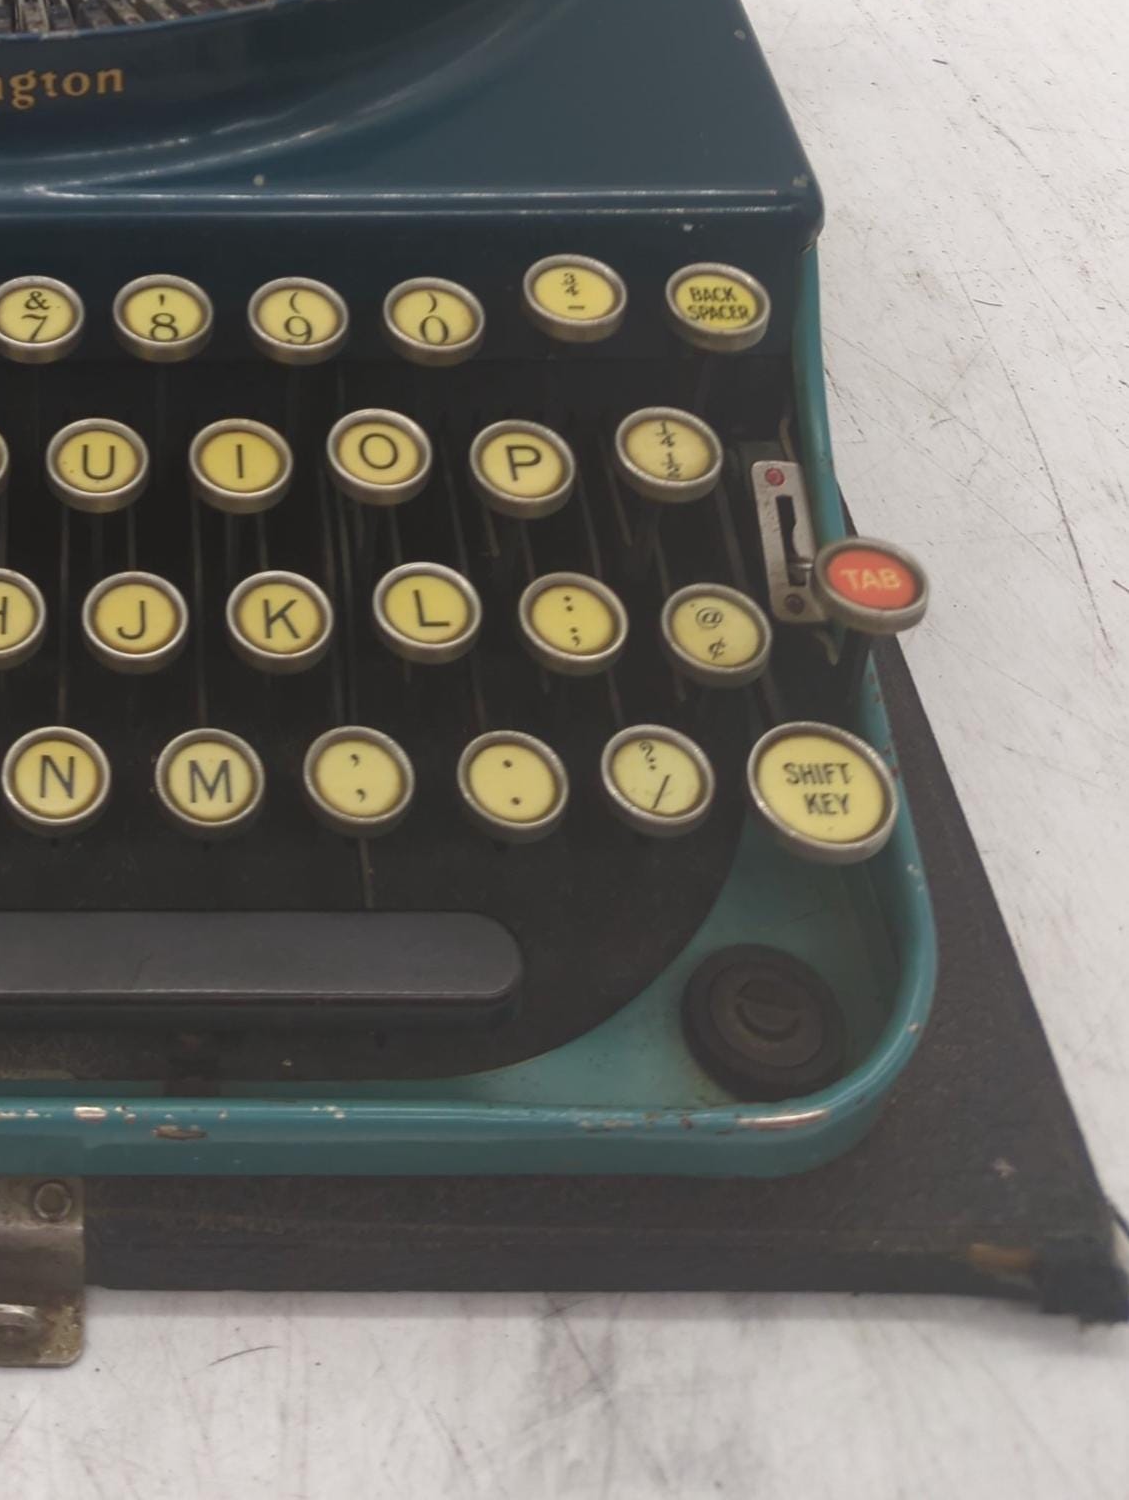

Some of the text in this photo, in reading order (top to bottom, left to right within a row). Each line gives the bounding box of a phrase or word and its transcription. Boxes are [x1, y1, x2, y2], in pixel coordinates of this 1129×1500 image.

[24, 290, 51, 311] &
[689, 287, 737, 302] BACK
[149, 312, 179, 342] 8
[687, 305, 750, 321] SPACER
[21, 315, 48, 342] 7
[283, 315, 312, 344] 9
[81, 444, 116, 480] U
[235, 443, 245, 479] I
[359, 433, 398, 470] O
[506, 445, 543, 482] P
[840, 566, 902, 592] TAB
[116, 600, 147, 640] J
[263, 598, 301, 640] K
[413, 589, 452, 628] L
[695, 606, 723, 630] @
[39, 754, 76, 799] N
[189, 759, 233, 803] M
[784, 761, 851, 786] SHIFT
[804, 792, 850, 816] KEY
